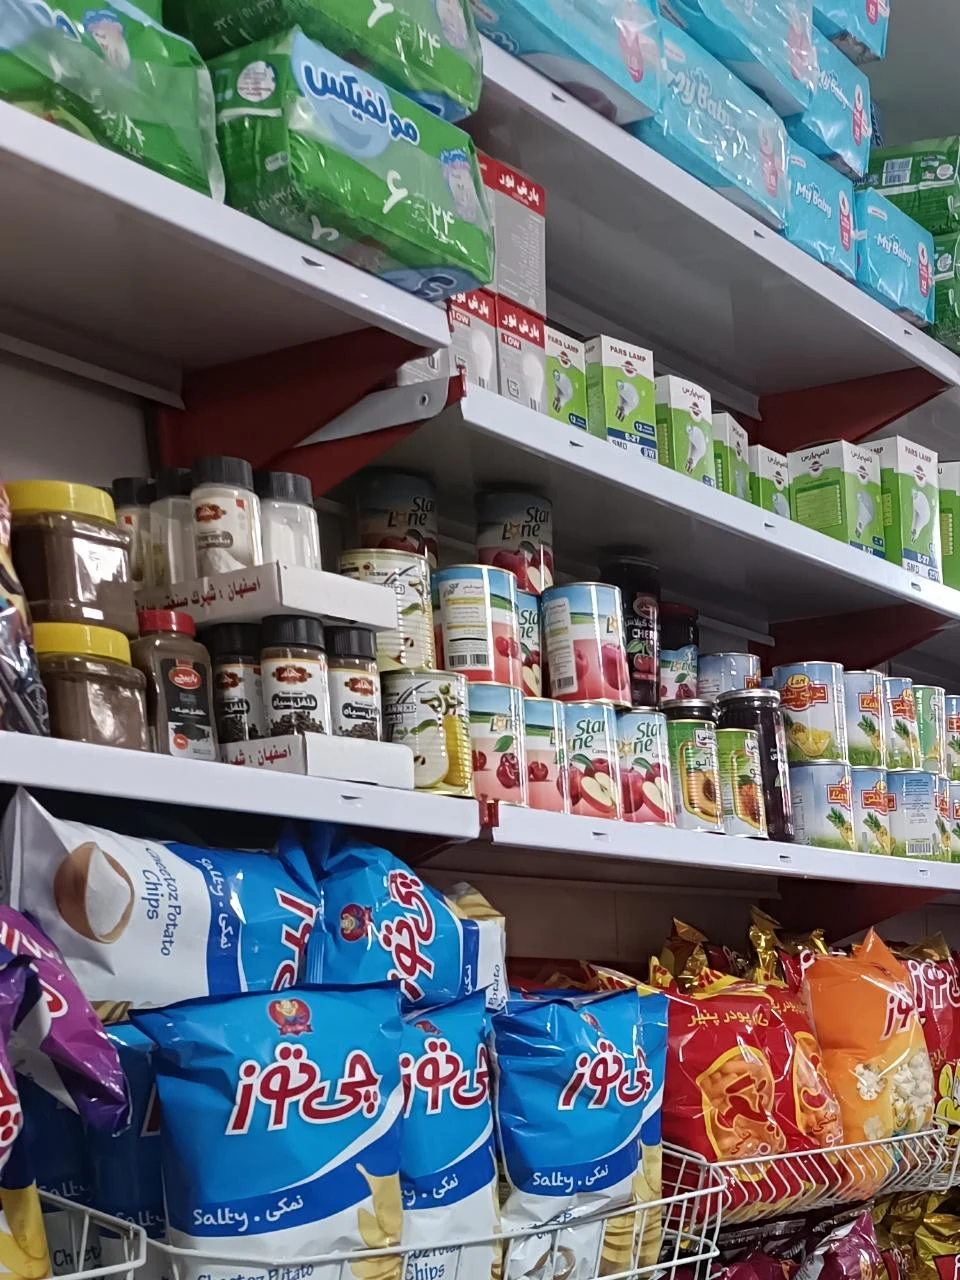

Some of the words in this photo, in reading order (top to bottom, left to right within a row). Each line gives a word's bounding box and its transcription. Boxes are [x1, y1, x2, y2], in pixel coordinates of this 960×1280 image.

[795, 183, 812, 205] My
[812, 192, 832, 219] Baby
[876, 232, 892, 254] My
[892, 241, 912, 267] Baby
[564, 342, 579, 354] LAMP
[609, 345, 628, 357] PARS
[628, 351, 647, 363] LAMP
[412, 496, 435, 513] Sta
[142, 868, 161, 921] Chips
[198, 857, 226, 897] Salty
[160, 903, 182, 957] Potato
[433, 1172, 460, 1199] نمکی
[532, 1171, 574, 1193] Salty
[584, 1164, 609, 1186] نمکی
[193, 1207, 249, 1232] Salty
[266, 1194, 304, 1221] نمکی
